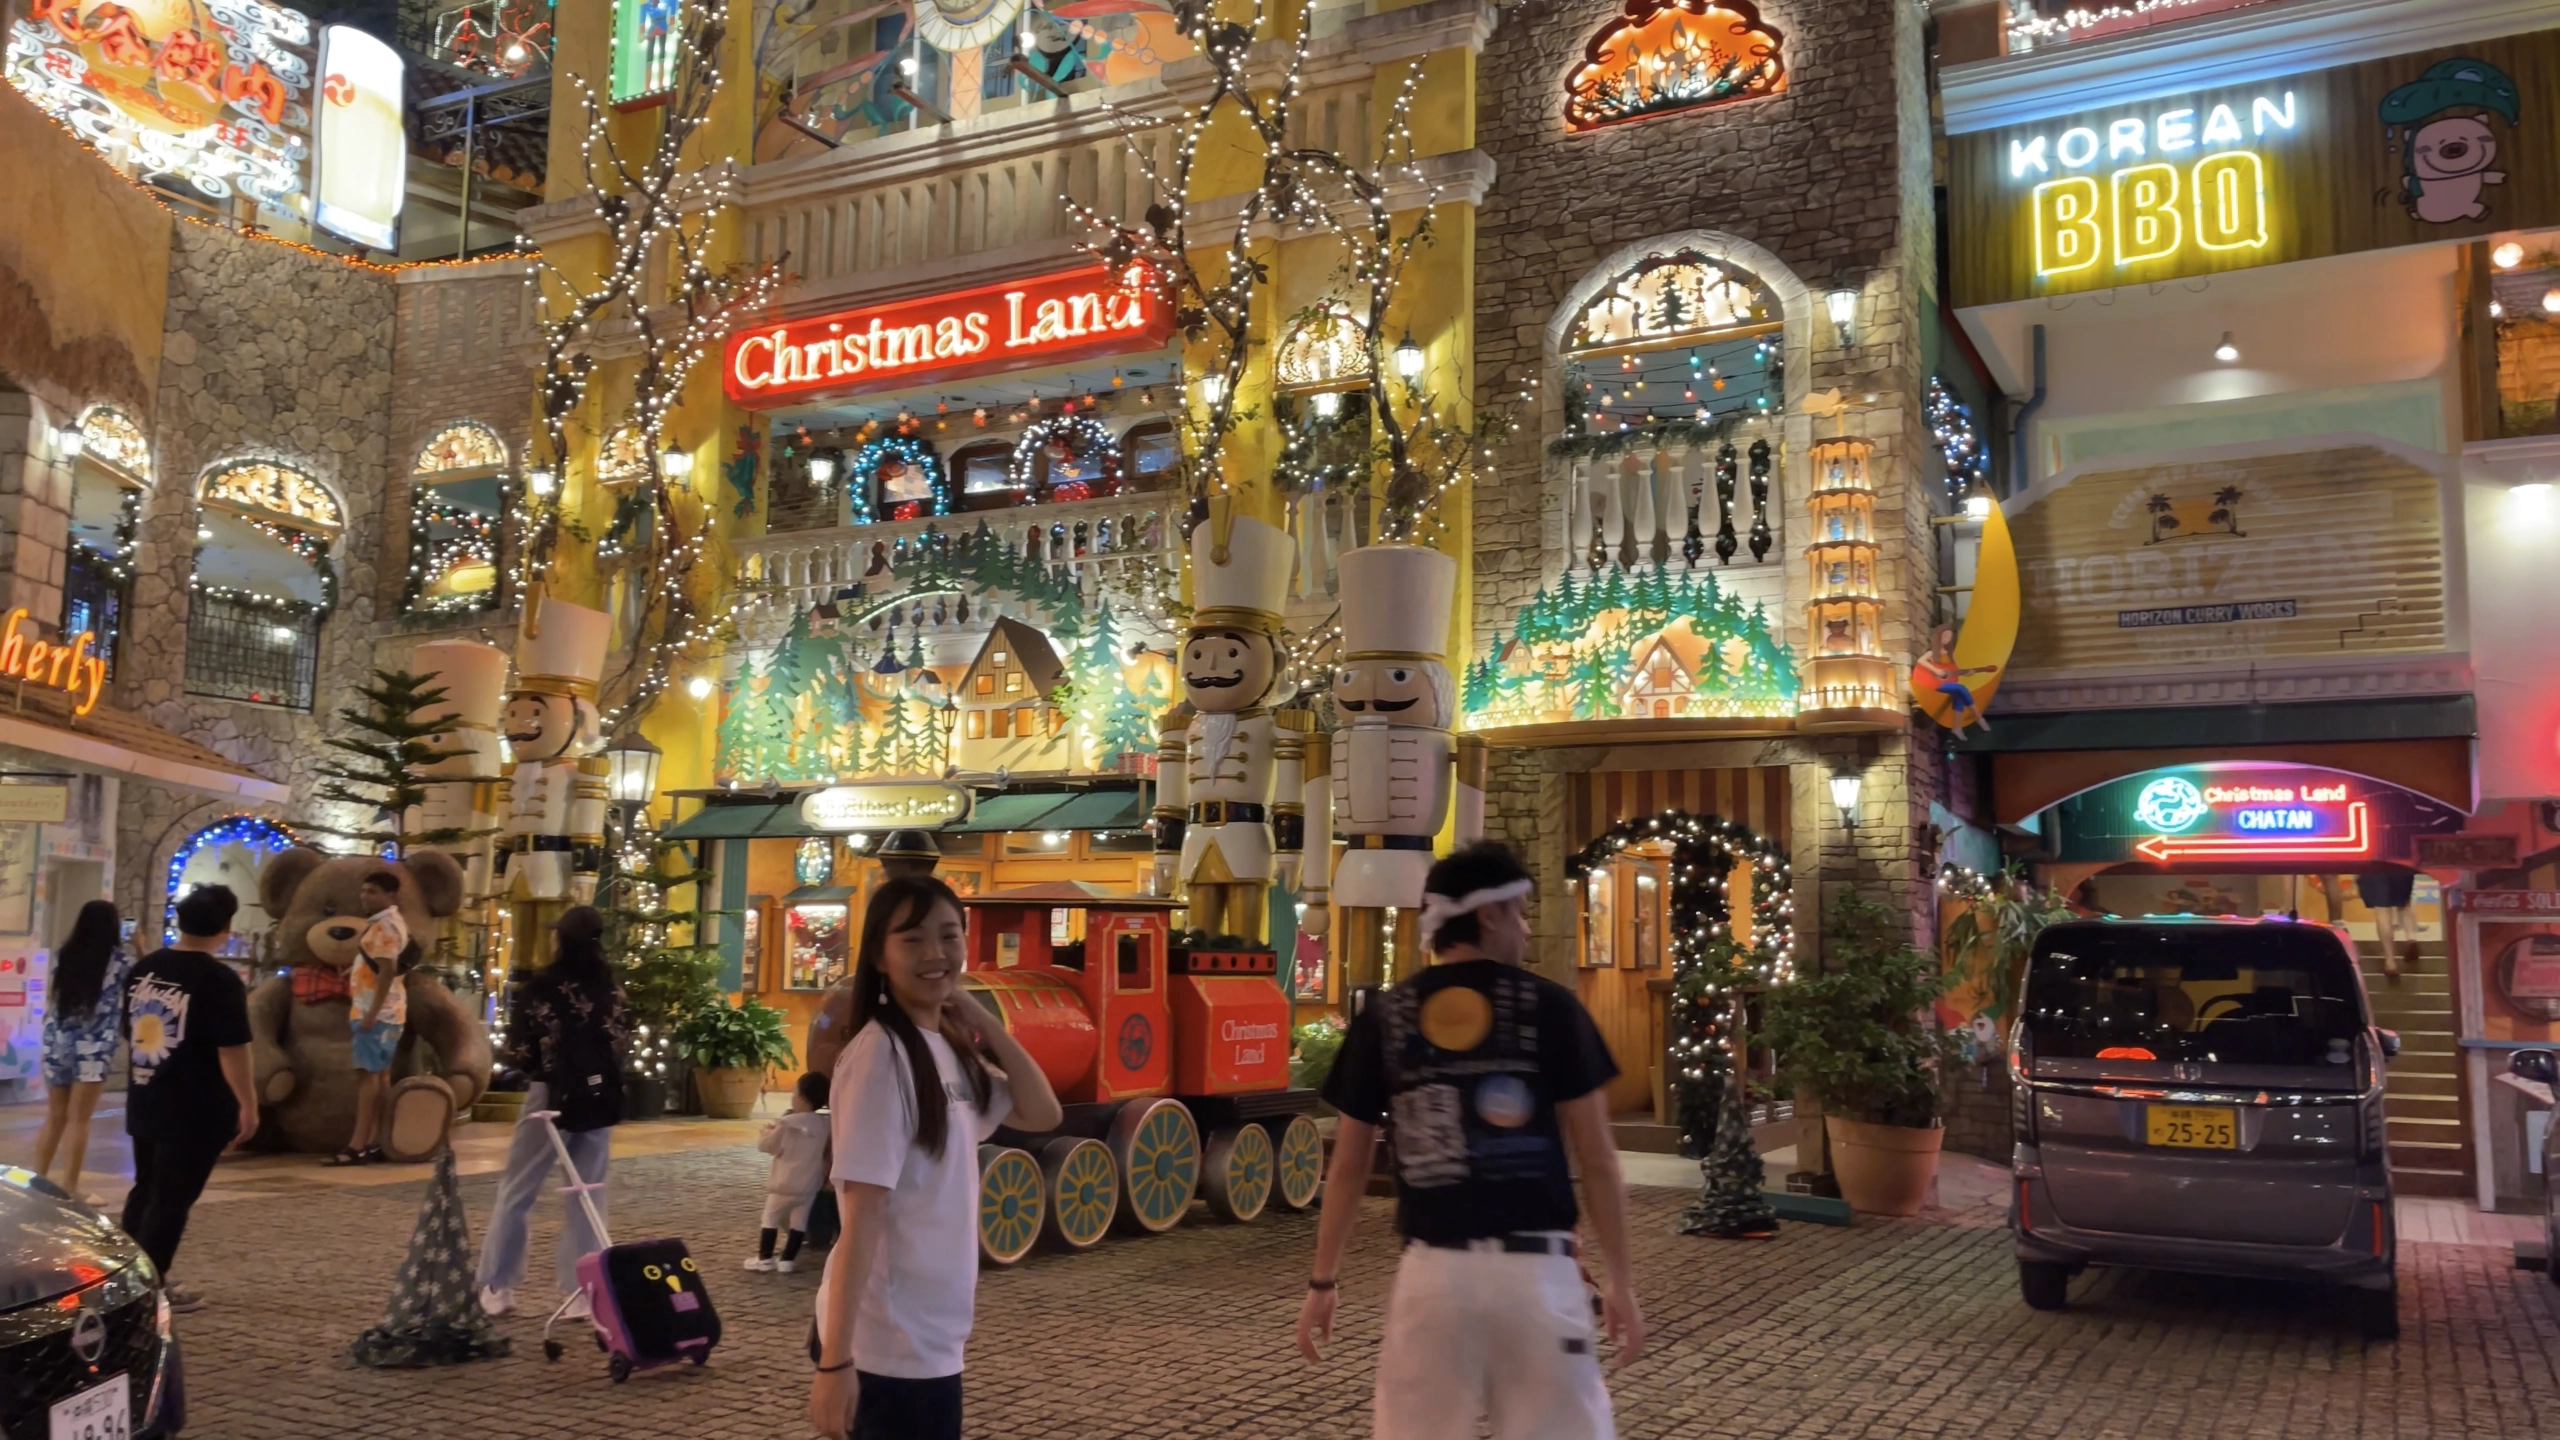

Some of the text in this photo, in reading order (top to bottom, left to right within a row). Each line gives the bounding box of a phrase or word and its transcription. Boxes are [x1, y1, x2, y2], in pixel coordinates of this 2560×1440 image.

[2010, 91, 2295, 177] KOREAN
[2033, 150, 2268, 277] BBQ
[734, 265, 1148, 389] Christmas Land
[2120, 601, 2294, 627] HORIZON CURRY WORKS
[2203, 784, 2347, 804] Christmas Land
[2238, 809, 2314, 830] CHATAN
[1221, 1019, 1279, 1042] Christmas
[1234, 1043, 1266, 1066] Land
[2167, 1122, 2231, 1145] 25-25
